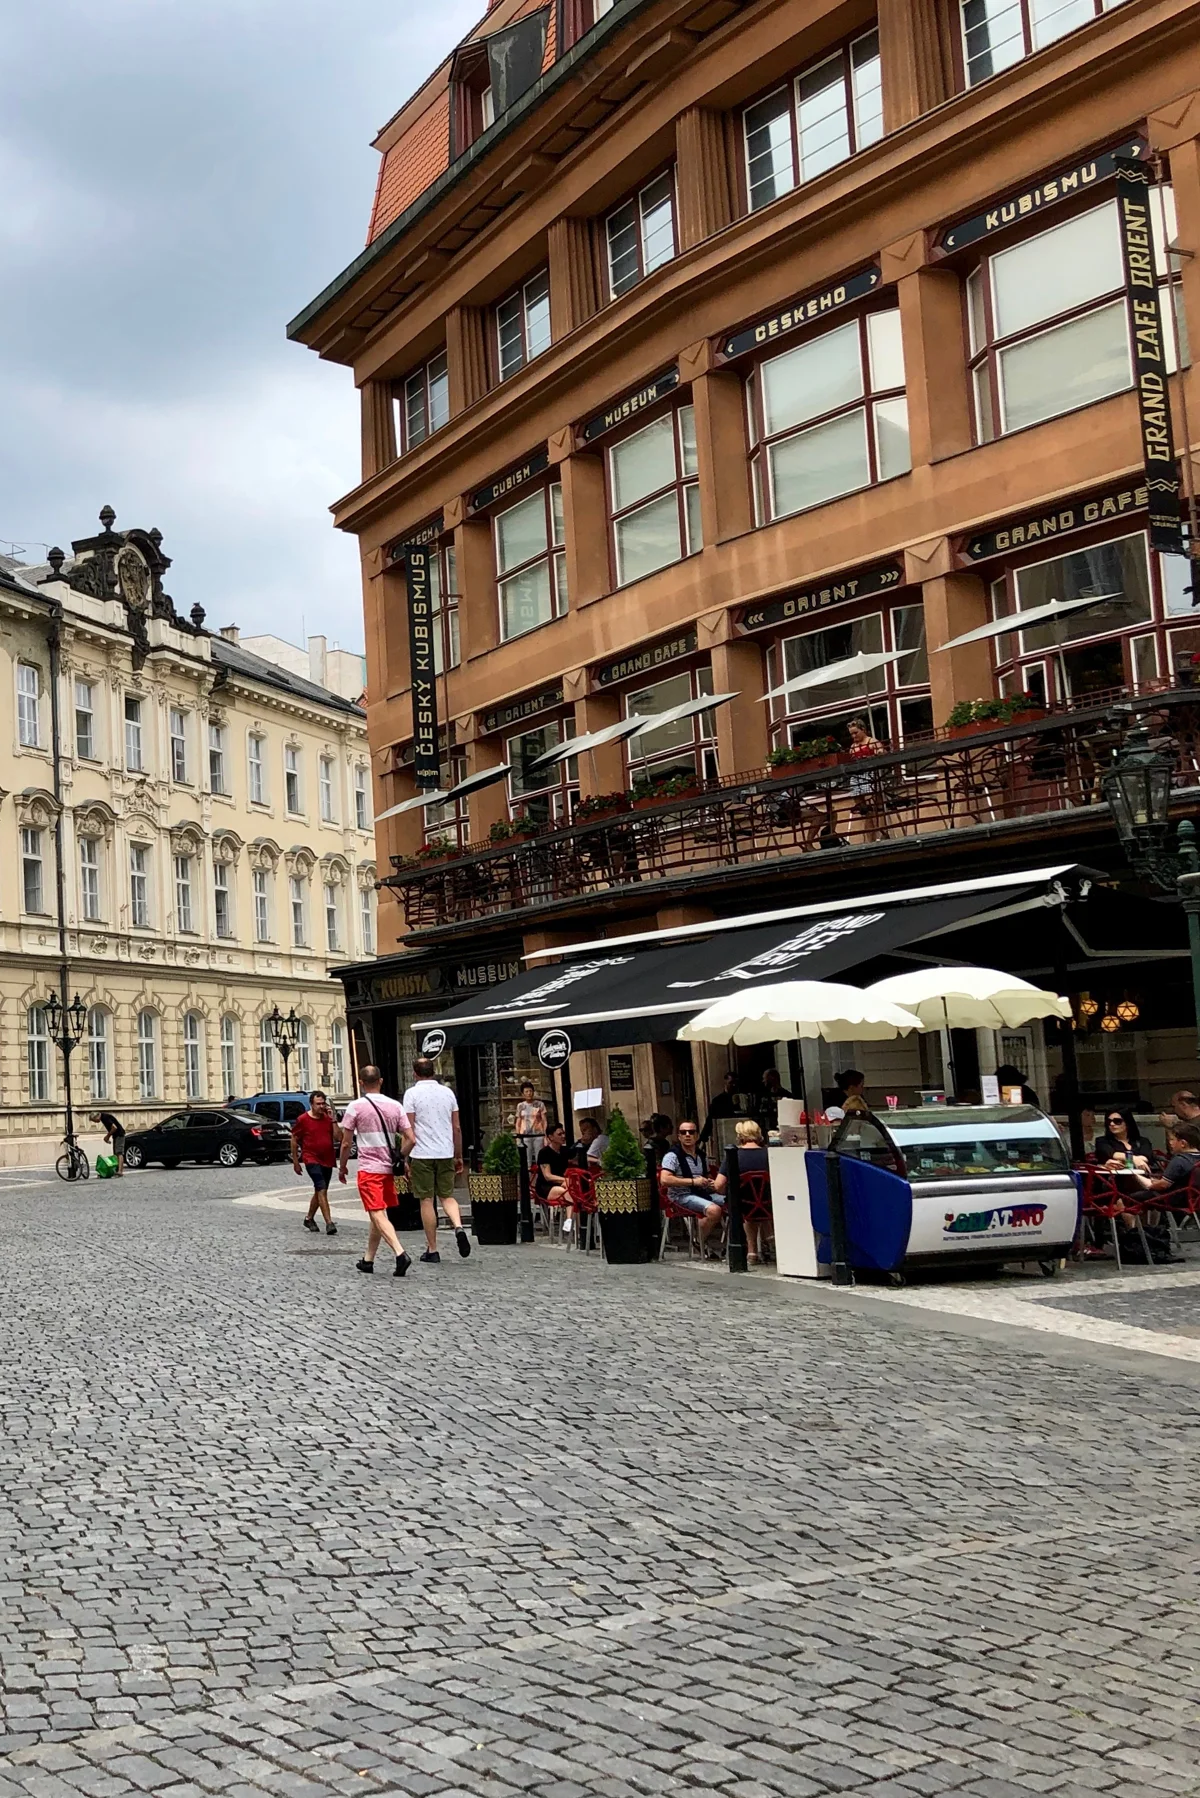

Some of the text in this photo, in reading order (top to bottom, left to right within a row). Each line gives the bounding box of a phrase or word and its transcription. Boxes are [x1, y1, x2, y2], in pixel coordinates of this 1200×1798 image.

[986, 162, 1097, 230] KUBISMU
[1123, 198, 1170, 462] GRAND CAFE ORIENT
[605, 385, 657, 428] MUSEUM
[492, 465, 531, 498] CUBISM
[402, 527, 433, 546] ZECH
[995, 486, 1149, 550] GRAND CAFE
[783, 580, 859, 617] ORIENT
[411, 553, 434, 756] ČESKÝ KUBISMUS
[611, 638, 687, 680] GRAND CAFE
[505, 695, 545, 721] ORIENT
[381, 975, 431, 999] KUBISTA
[456, 961, 519, 986] MUSEUM
